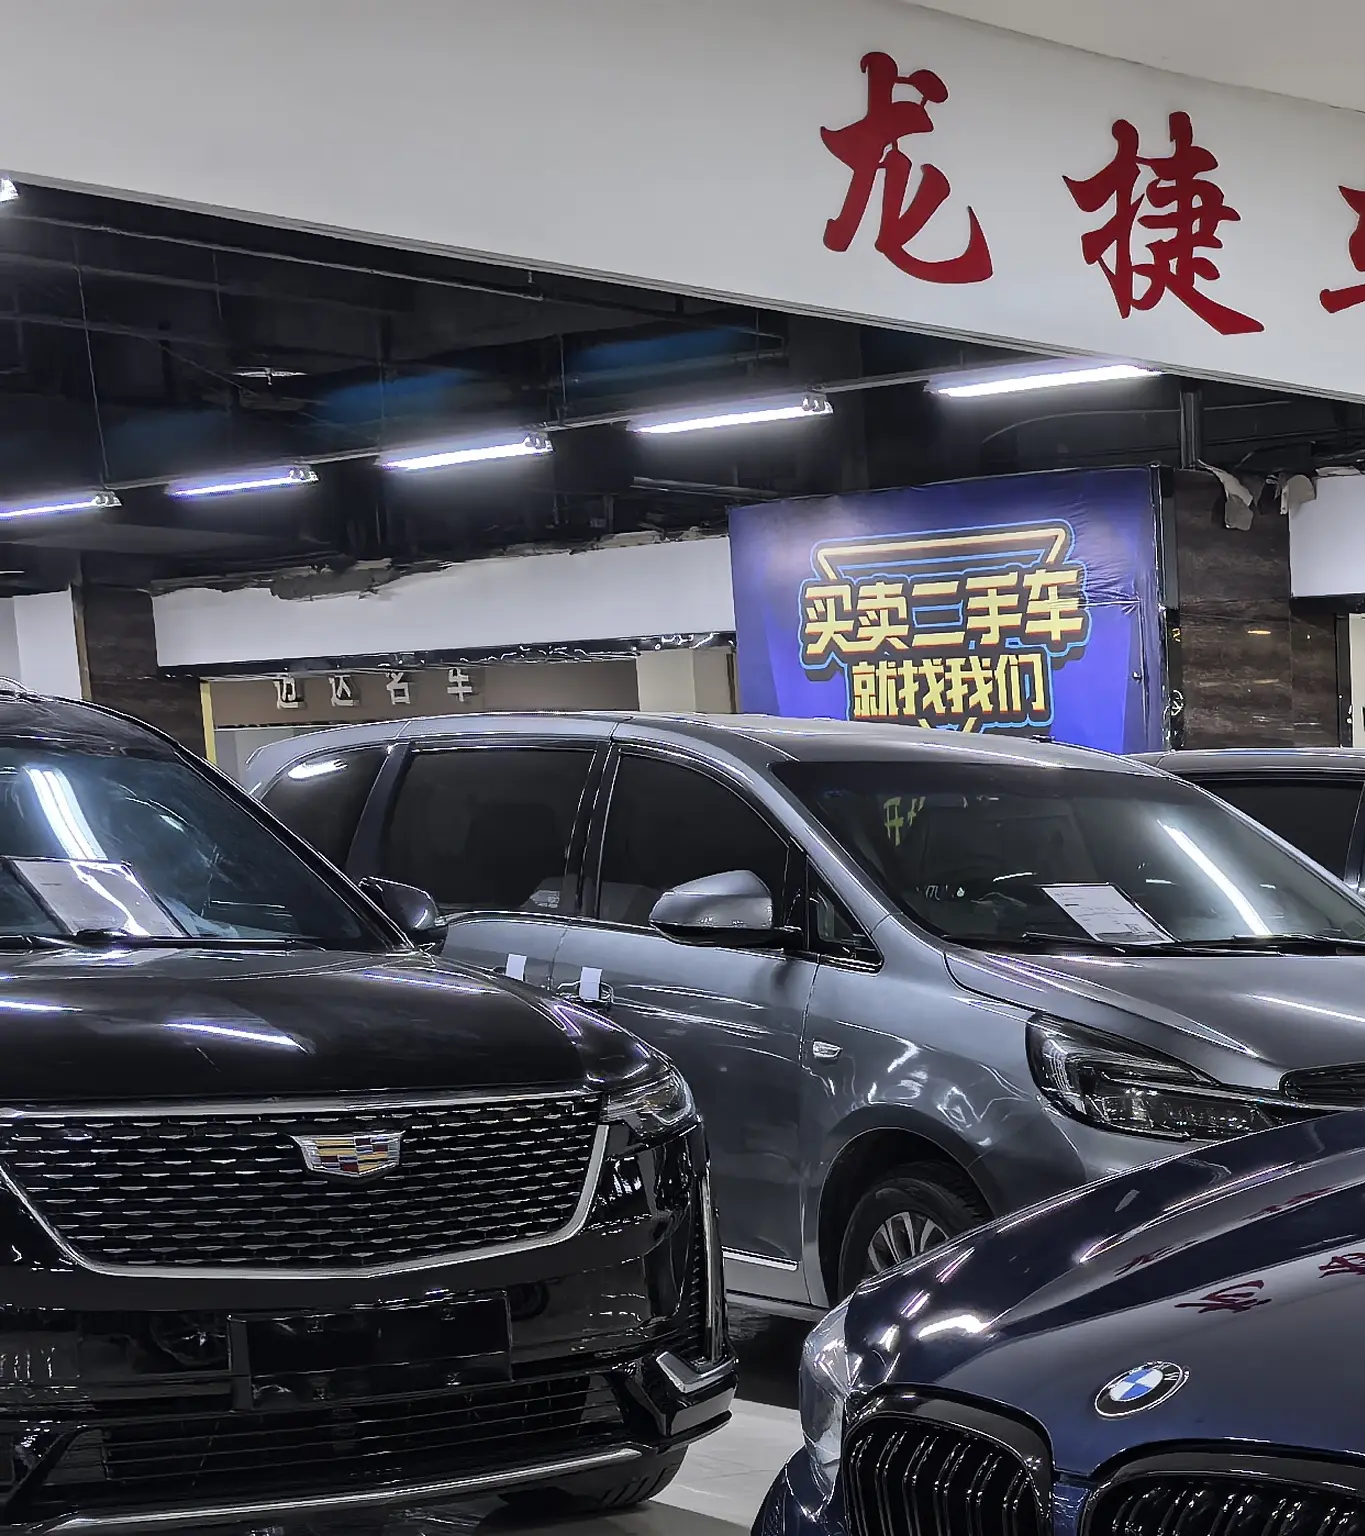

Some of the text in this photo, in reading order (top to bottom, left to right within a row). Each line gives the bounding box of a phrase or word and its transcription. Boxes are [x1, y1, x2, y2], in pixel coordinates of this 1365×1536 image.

[804, 569, 1084, 655] 买卖二手车
[852, 652, 1046, 720] 就找我们
